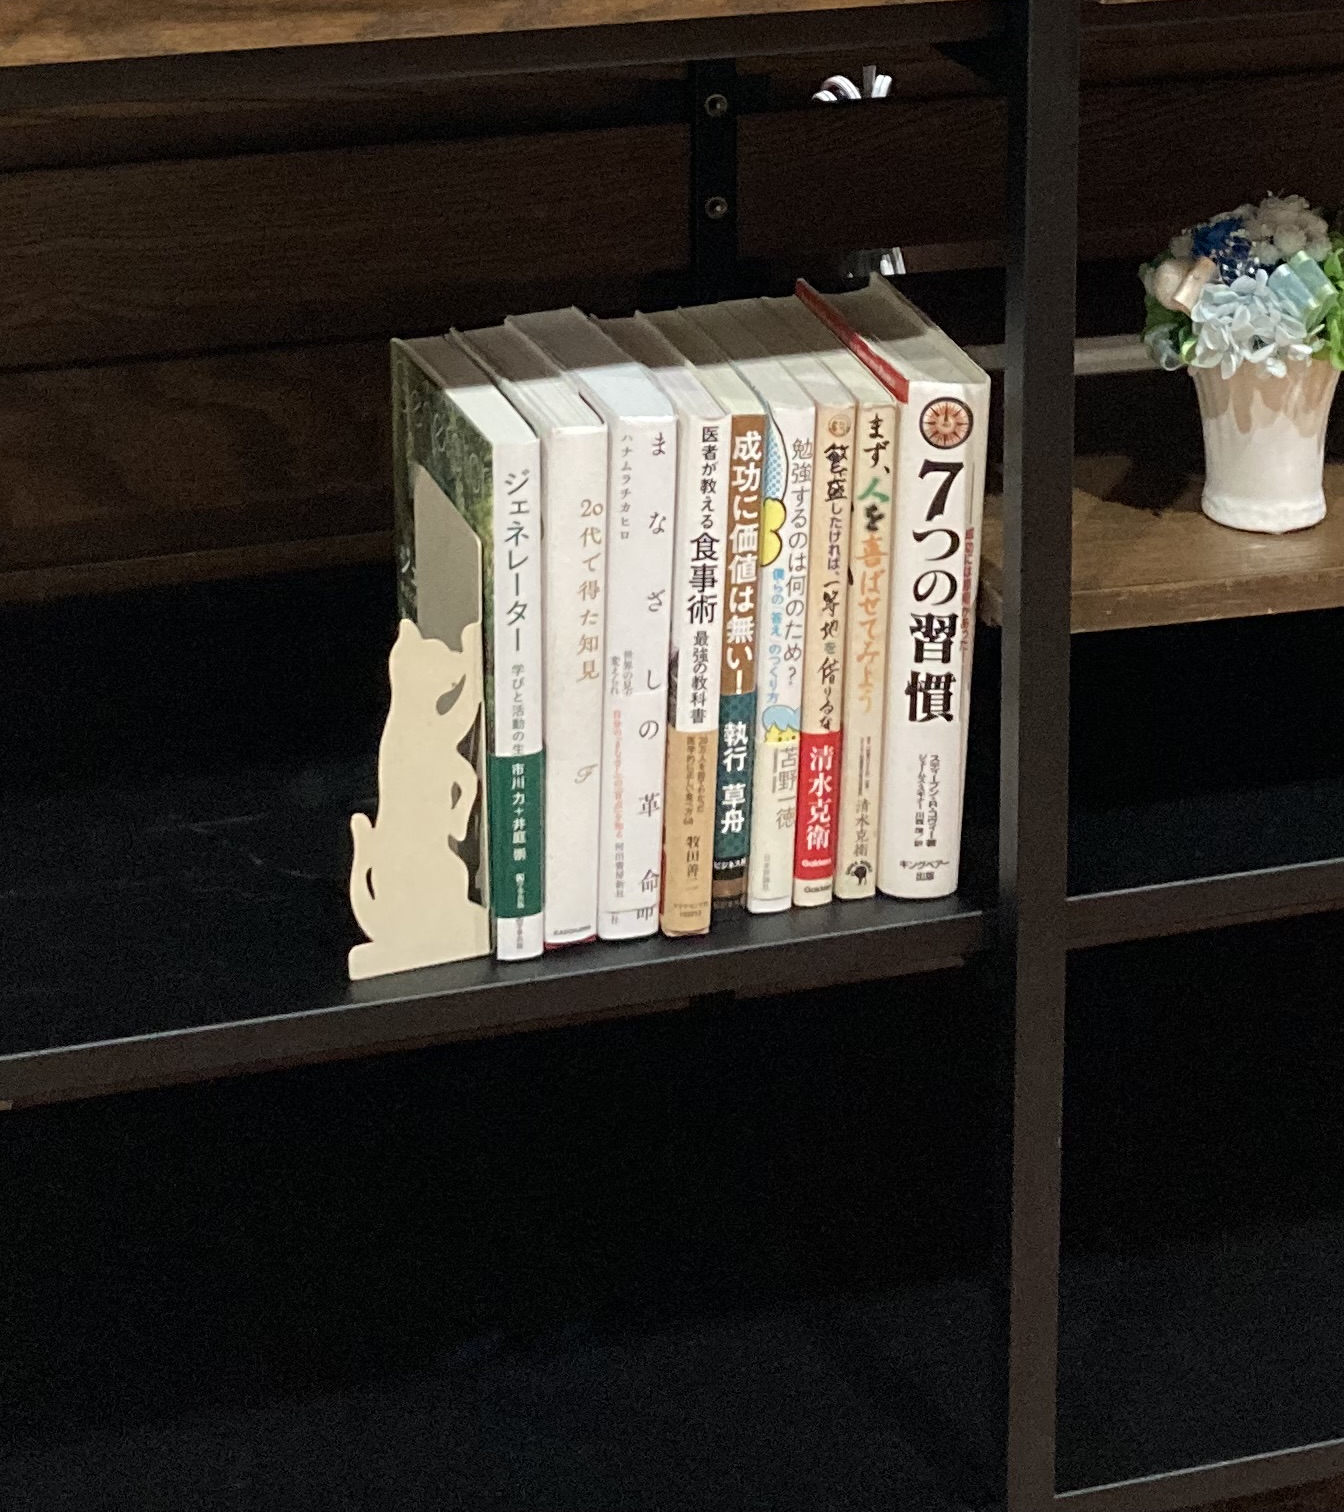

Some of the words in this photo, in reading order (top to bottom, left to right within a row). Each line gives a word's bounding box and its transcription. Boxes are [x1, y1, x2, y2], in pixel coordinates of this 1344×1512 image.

[504, 468, 531, 651] ジェネレーター
[620, 434, 633, 540] ハナムラチカヒロ
[687, 425, 720, 625] 医者が教える食事術
[726, 430, 763, 695] 成功に価値は無い!
[783, 437, 813, 686] 勉強するのは何のため?
[856, 413, 890, 714] まず、人を喜ばせてみよう
[905, 459, 964, 724] 7つの習慣
[638, 431, 666, 894] まなざしの革命
[690, 630, 710, 724] 最強の教科書
[806, 745, 835, 851] 清水克衛
